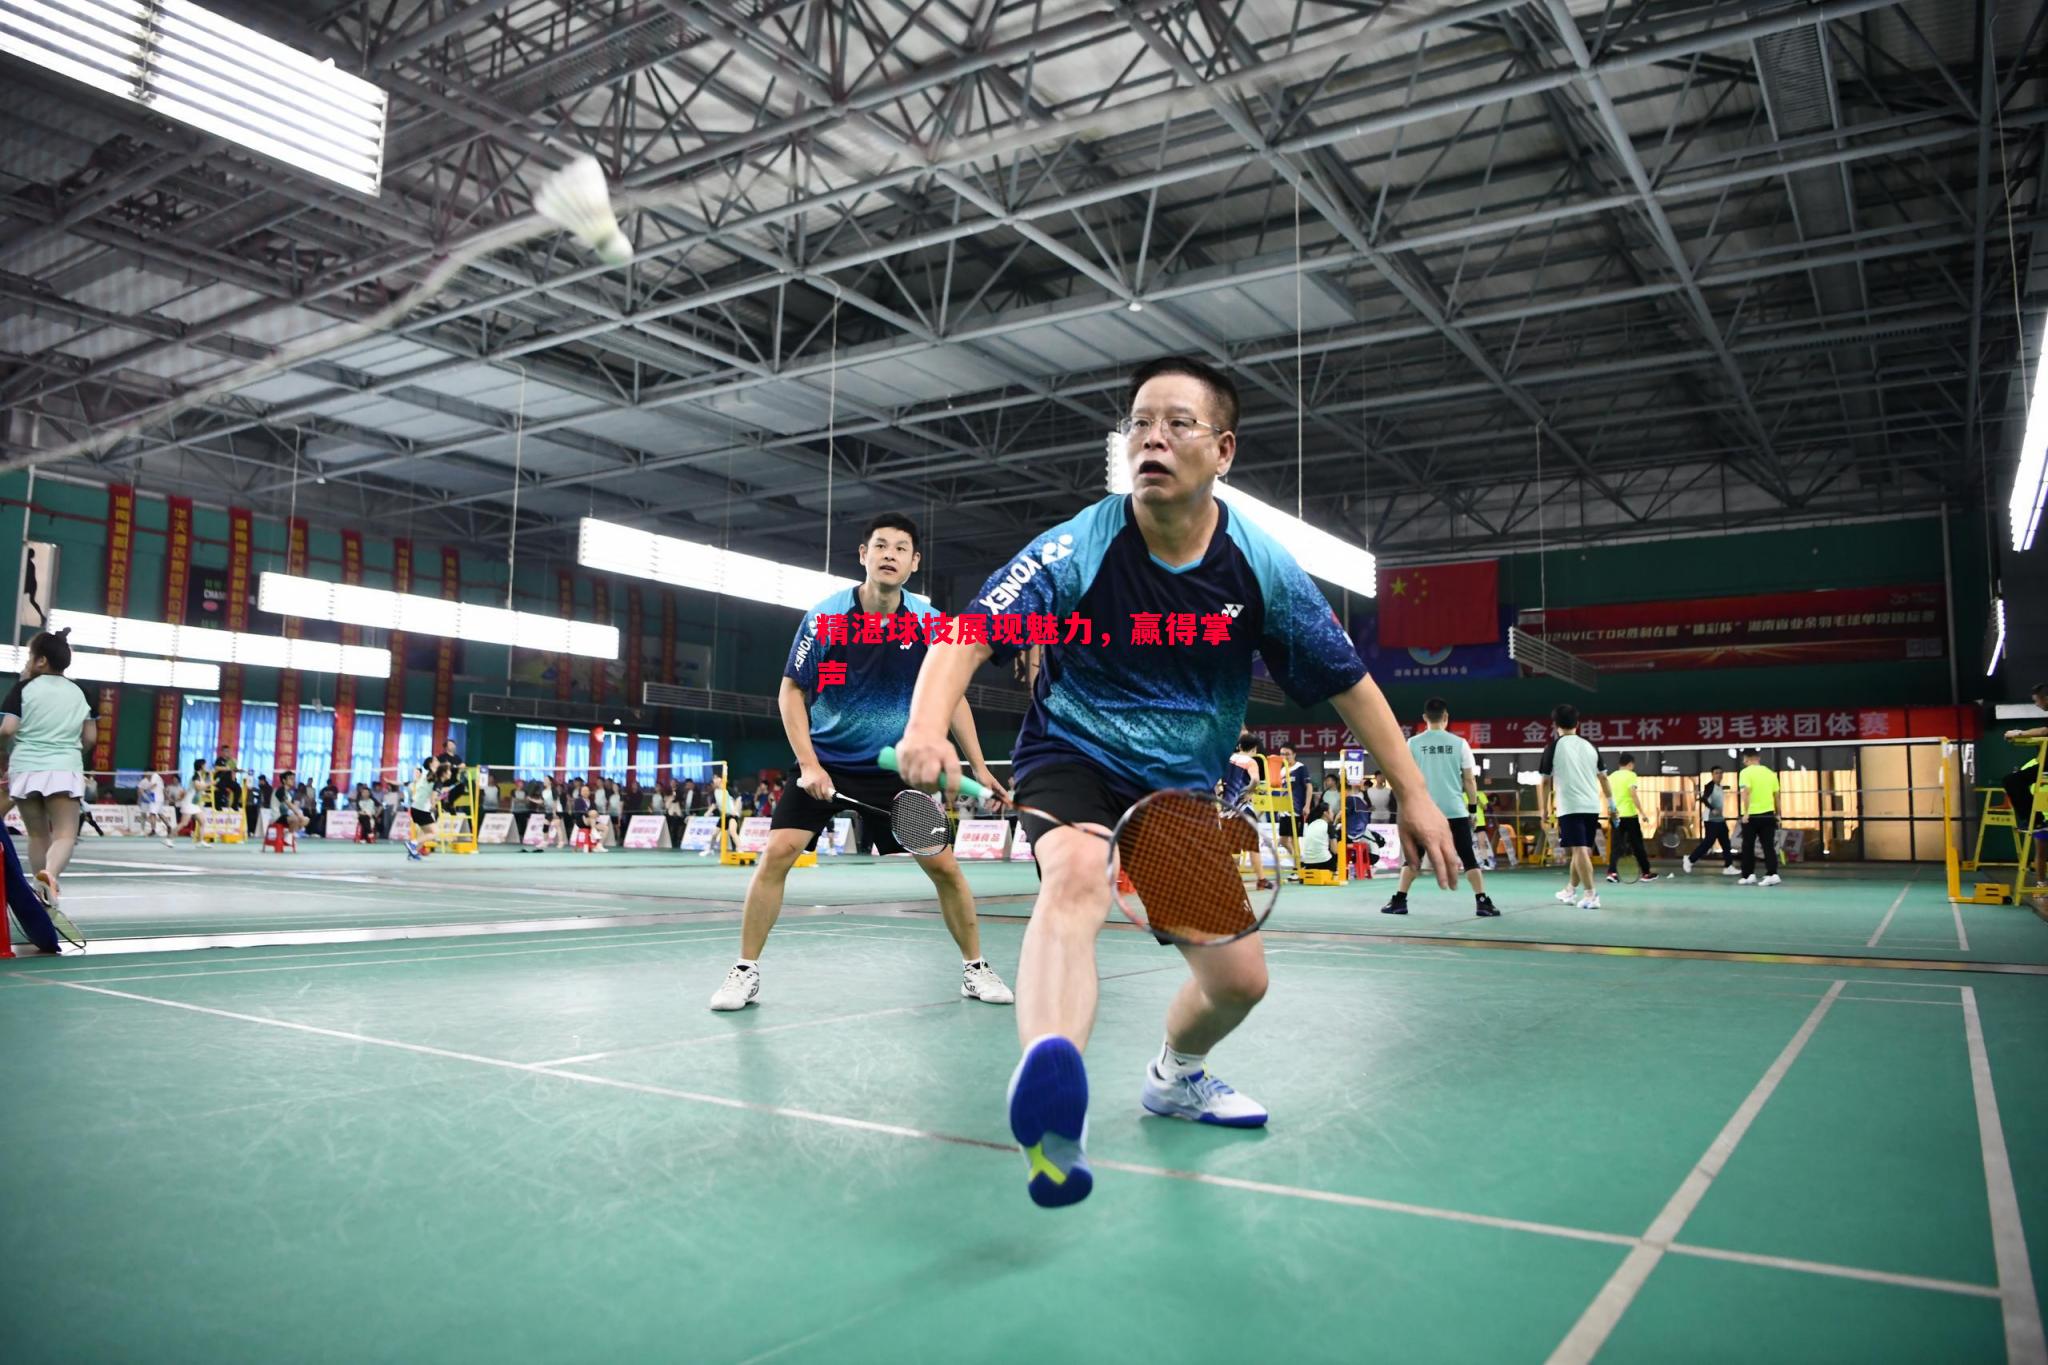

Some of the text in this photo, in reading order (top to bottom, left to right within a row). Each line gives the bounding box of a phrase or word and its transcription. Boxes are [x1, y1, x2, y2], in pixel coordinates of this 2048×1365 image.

[979, 555, 1043, 615] YONEX
[794, 635, 814, 672] YONEX
[1420, 745, 1454, 755] 千金集团
[1348, 765, 1360, 777] 11
